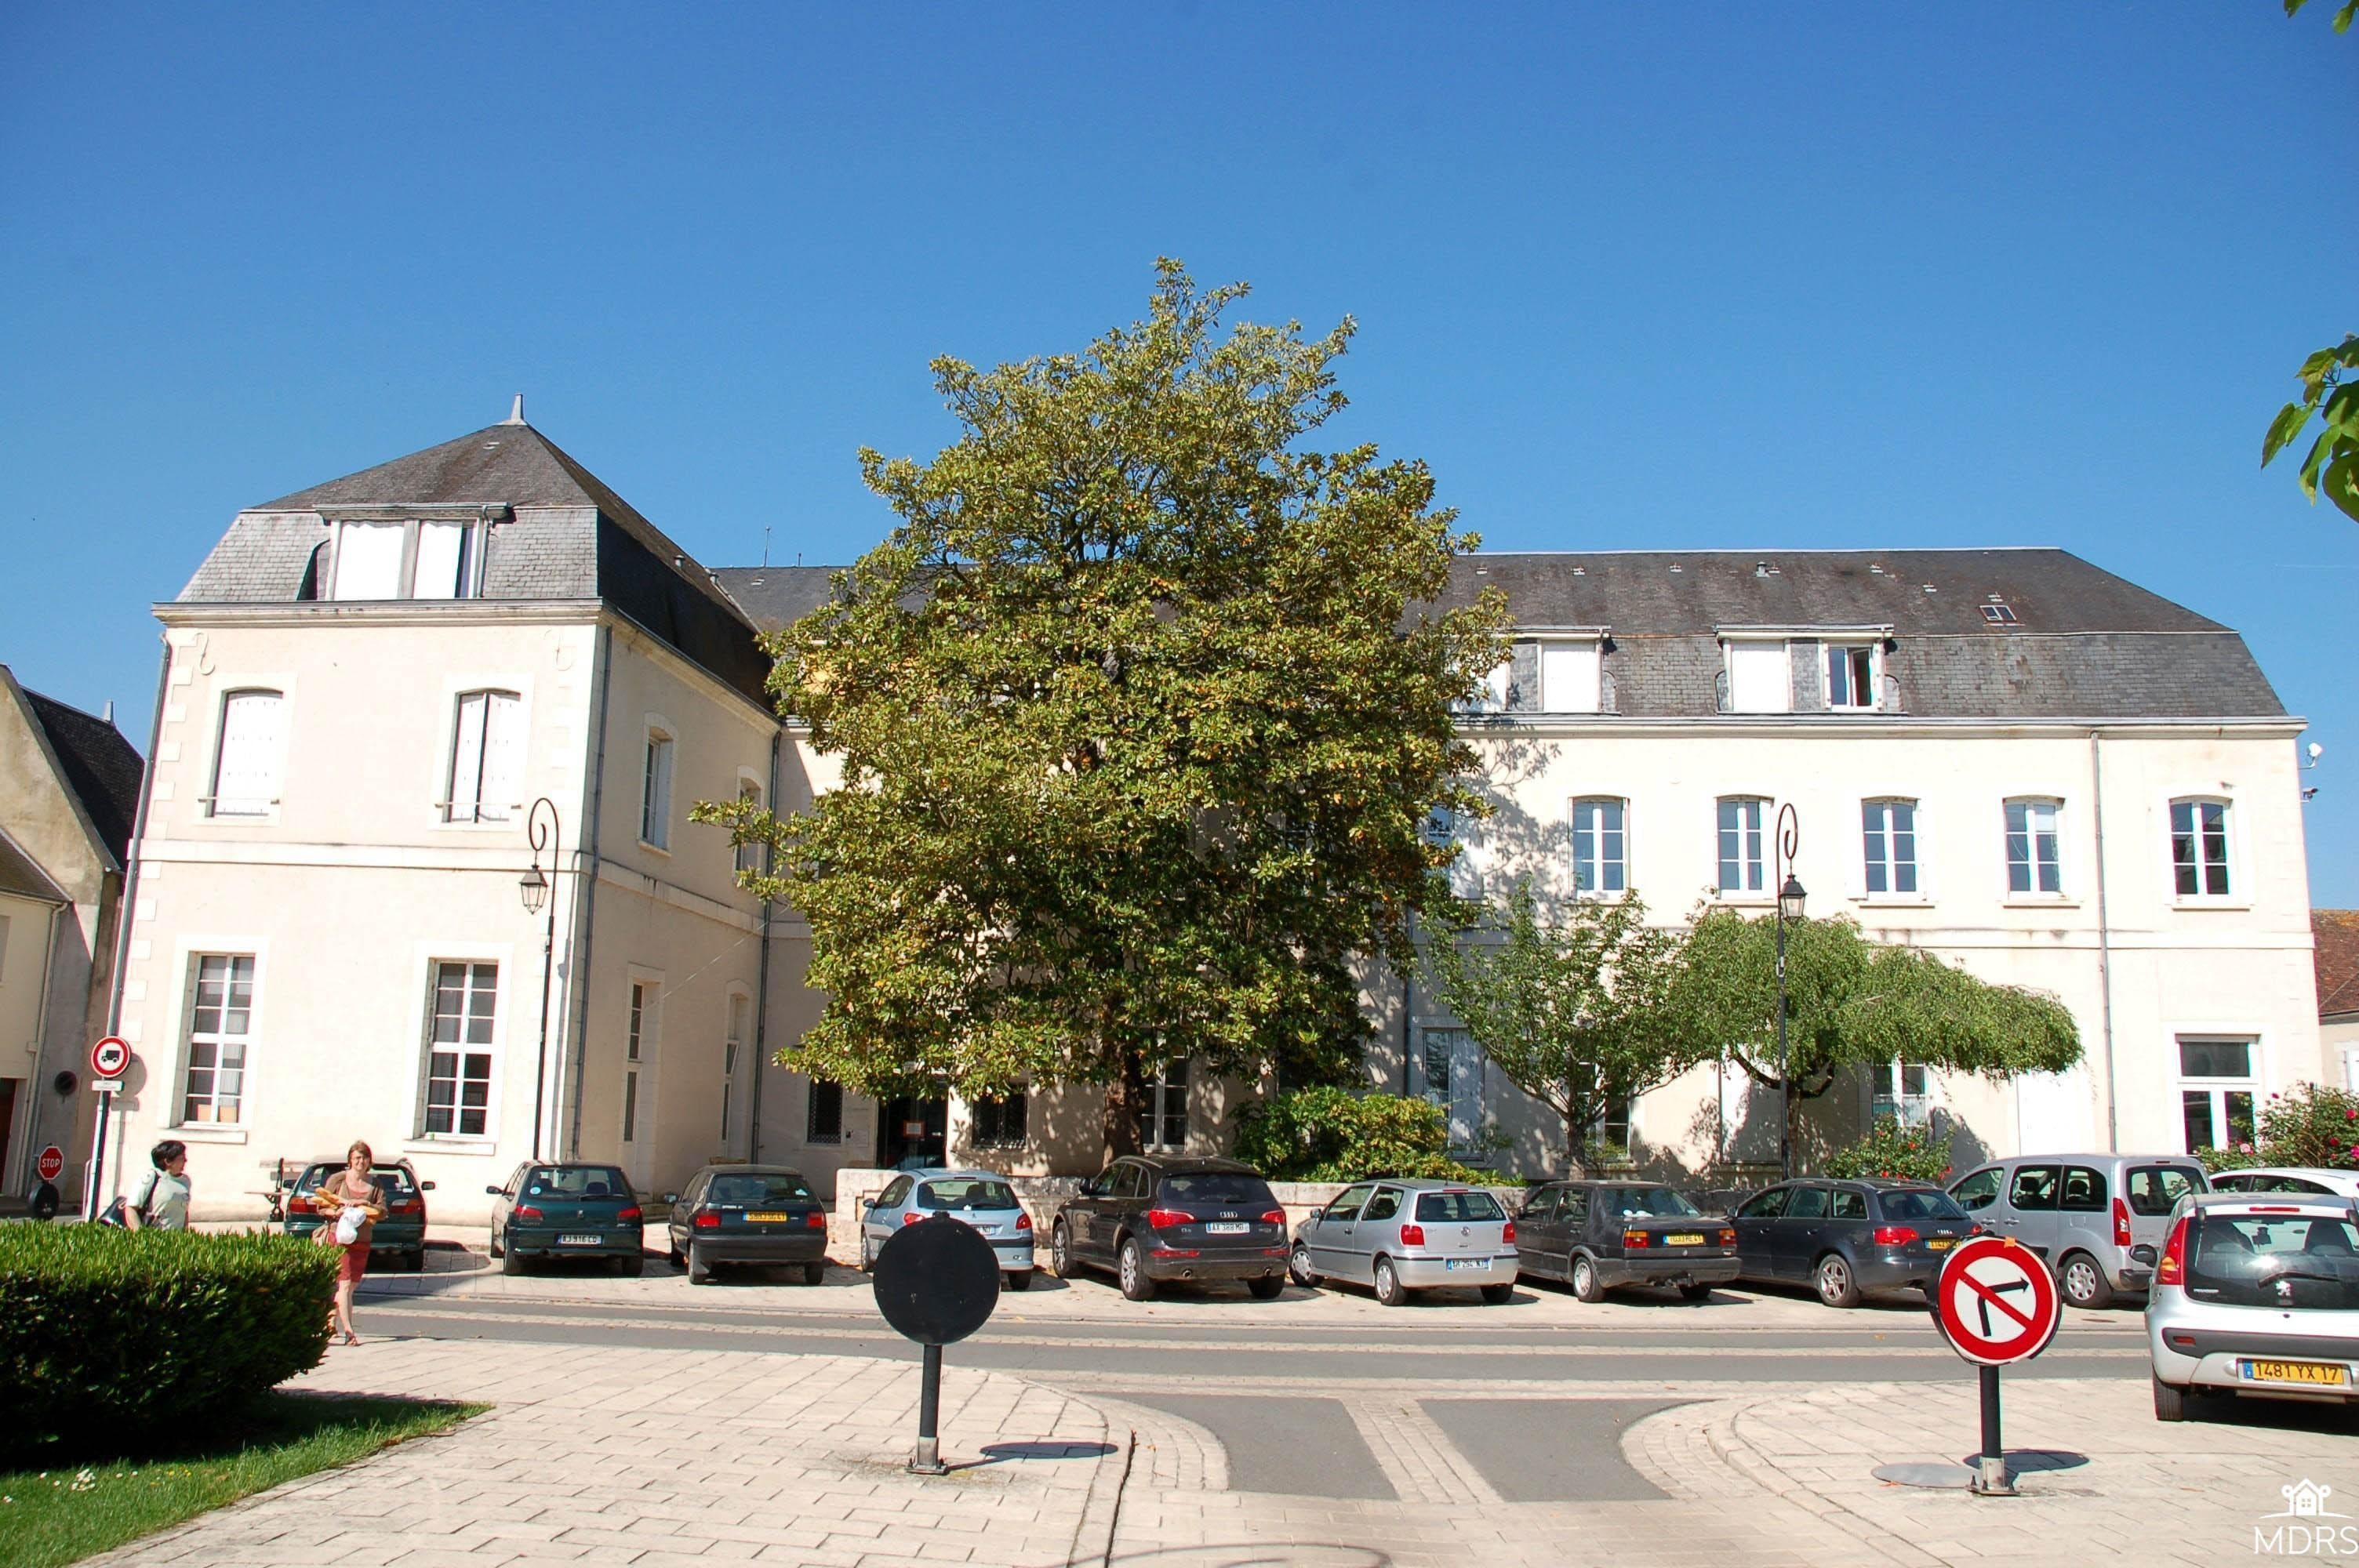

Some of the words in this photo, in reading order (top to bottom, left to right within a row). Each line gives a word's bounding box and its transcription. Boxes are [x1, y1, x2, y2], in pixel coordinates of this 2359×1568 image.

[42, 1158, 60, 1168] STOP
[2255, 1363, 2291, 1377] 1481
[2295, 1365, 2315, 1380] YX
[2321, 1367, 2338, 1381] 17
